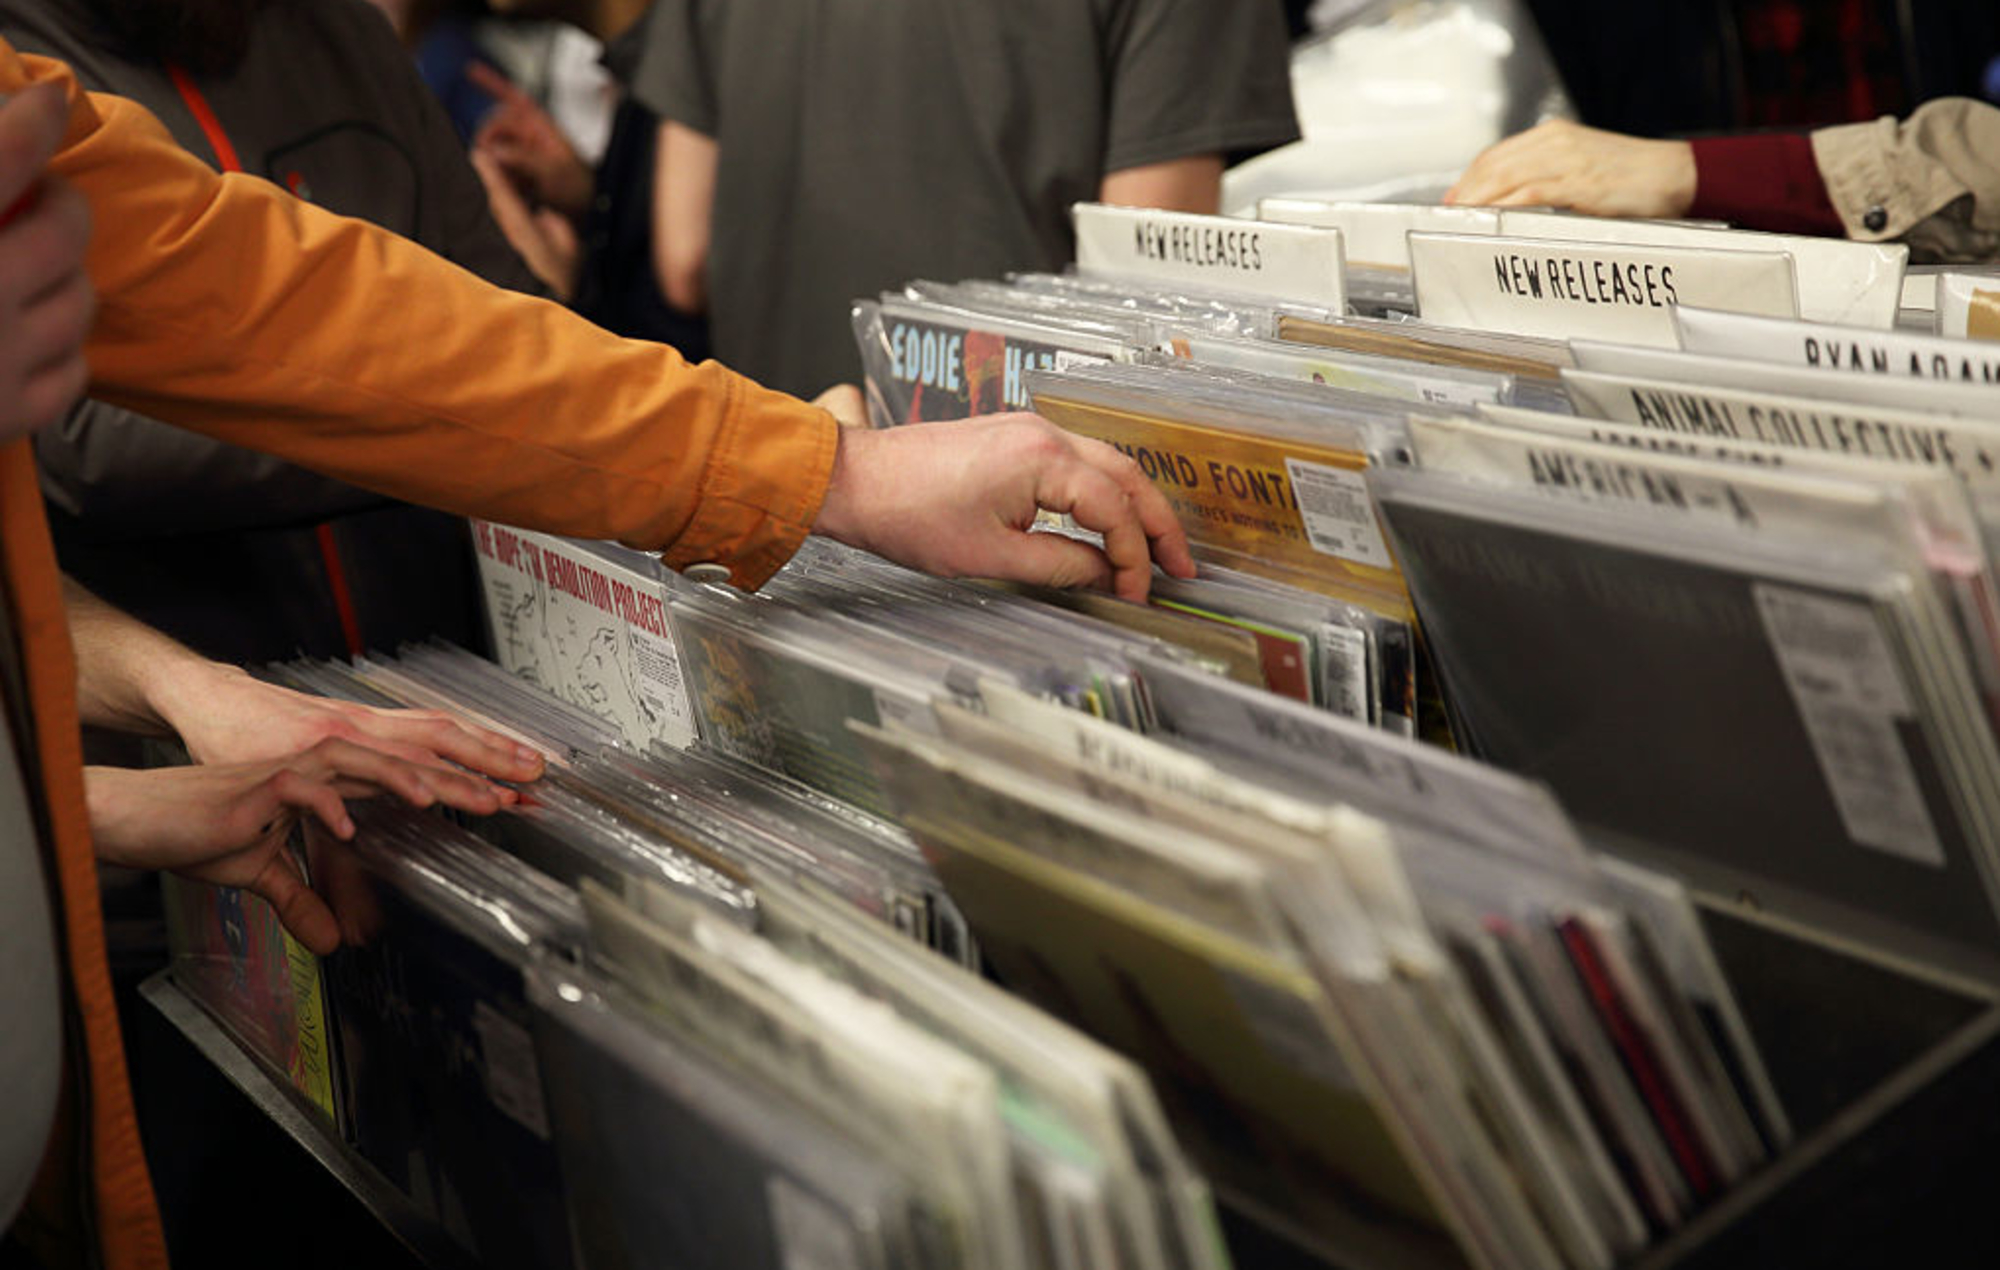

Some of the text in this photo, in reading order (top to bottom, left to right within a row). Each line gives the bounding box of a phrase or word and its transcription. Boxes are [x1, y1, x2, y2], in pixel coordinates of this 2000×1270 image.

[1135, 222, 1262, 270] NEW RELEASES
[1494, 255, 1678, 307] NEW RELEASES
[891, 323, 961, 392] EDDIE
[1805, 337, 1889, 373] RYAN
[1630, 388, 1740, 439] ANIMAL
[1748, 404, 1955, 467] COLLECTIVE
[543, 549, 614, 615] DEMOLITION
[612, 578, 668, 639] PROJECT
